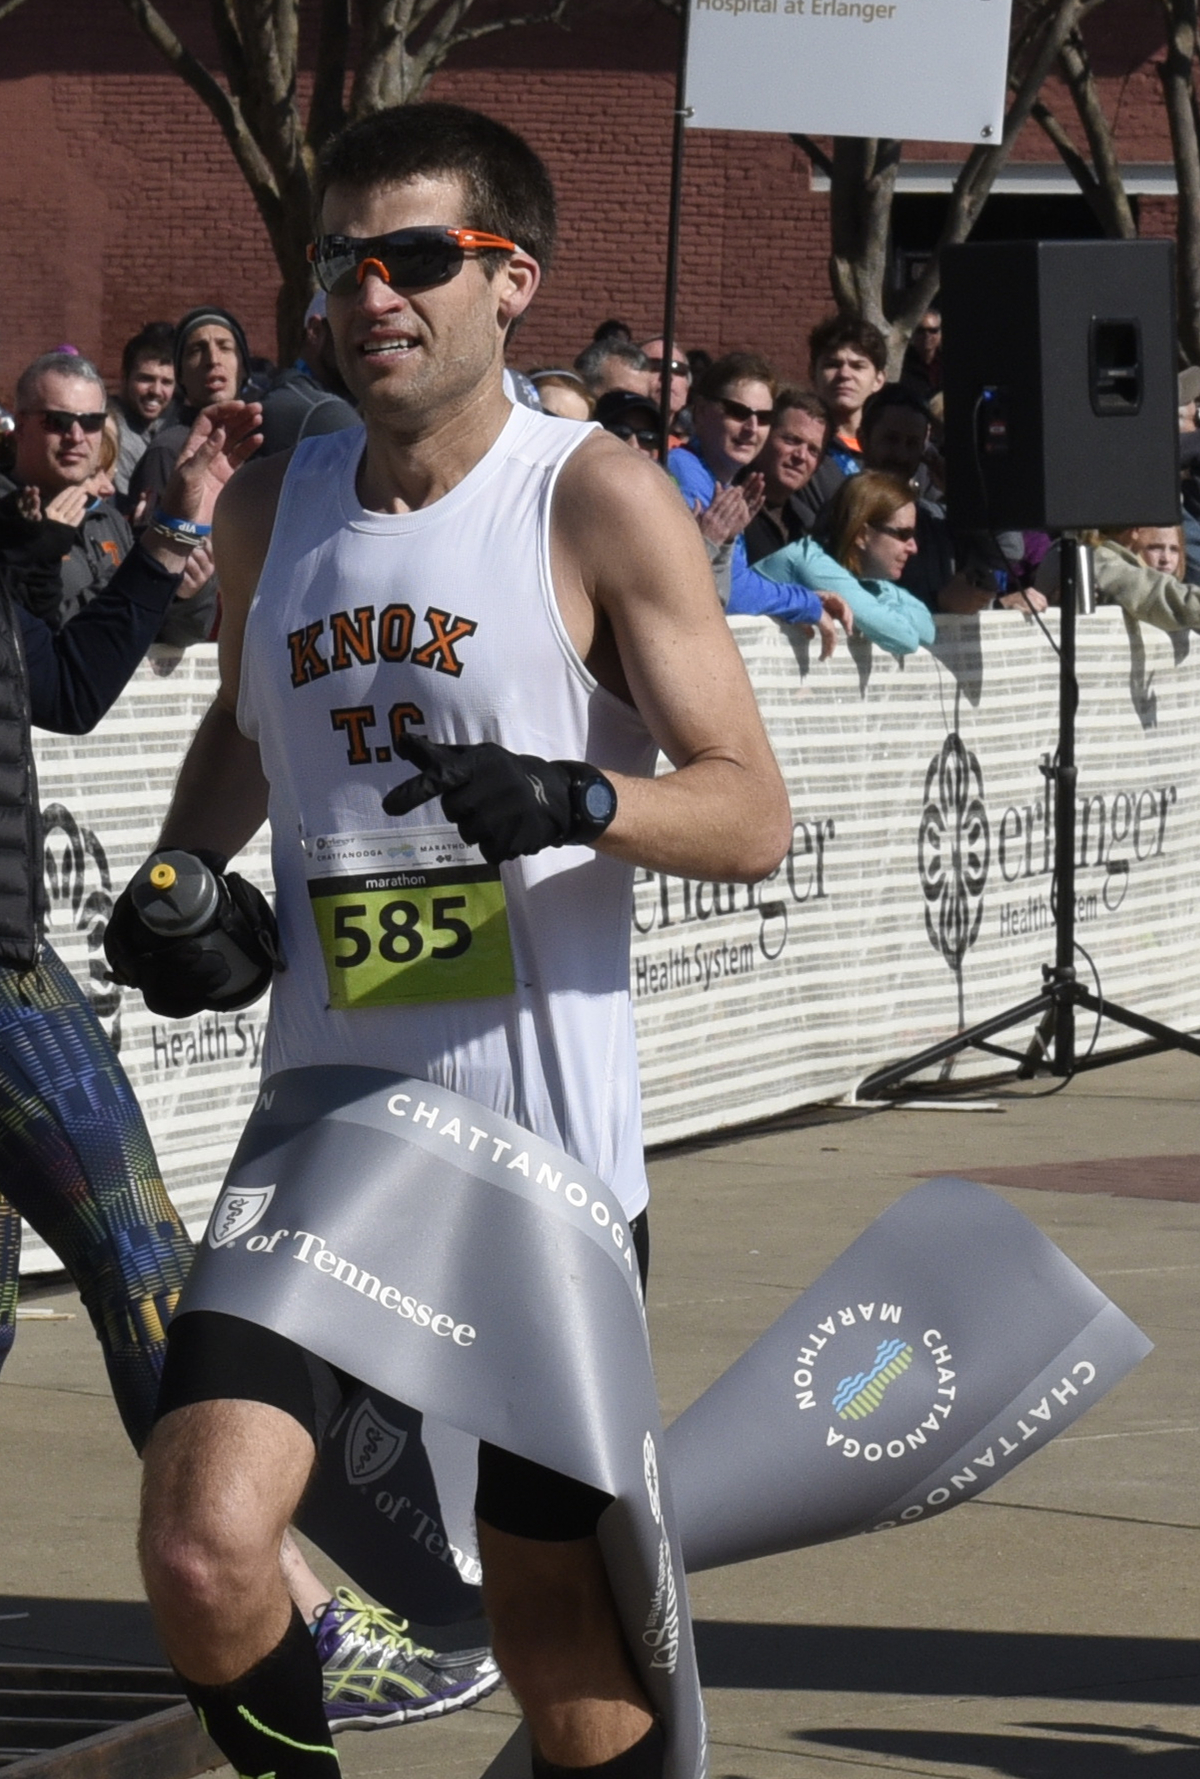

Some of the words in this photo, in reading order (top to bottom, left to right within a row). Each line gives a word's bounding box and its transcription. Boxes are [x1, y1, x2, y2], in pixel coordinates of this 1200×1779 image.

[695, 0, 777, 17] Hospital
[784, 0, 805, 15] at
[811, 0, 897, 23] Erlanger
[178, 522, 197, 534] VIP
[287, 603, 479, 689] KNOX
[998, 752, 1178, 912] erlnger
[365, 873, 427, 890] marathon
[334, 895, 473, 969] 585
[635, 941, 692, 997] Health
[693, 938, 755, 992] System
[151, 1011, 229, 1070] Health
[387, 1093, 633, 1272] CHATTANOOGA
[246, 1229, 289, 1254] of
[293, 1230, 477, 1347] Tennessee
[794, 1302, 902, 1410] MARATHON
[826, 1329, 956, 1462] CHATTANOOGA
[861, 1360, 1096, 1534] CHATTANOOG
[375, 1491, 411, 1523] of
